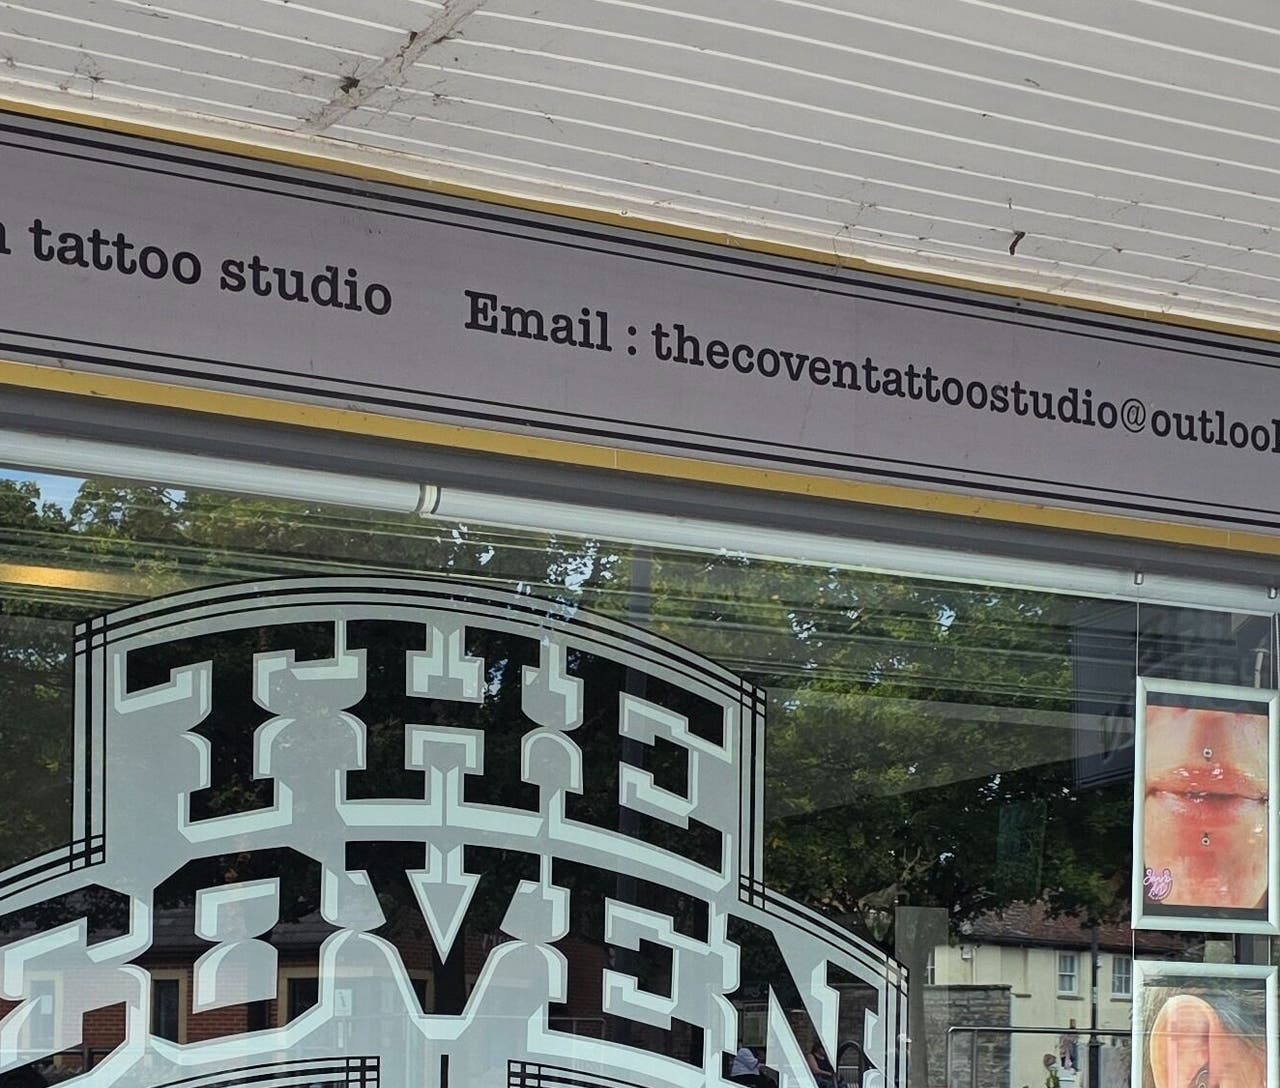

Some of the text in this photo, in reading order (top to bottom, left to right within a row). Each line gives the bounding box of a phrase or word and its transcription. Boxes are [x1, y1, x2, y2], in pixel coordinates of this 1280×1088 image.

[28, 218, 202, 285] tattoo
[219, 255, 392, 316] studio
[464, 289, 613, 352] Email
[120, 619, 733, 891] THE
